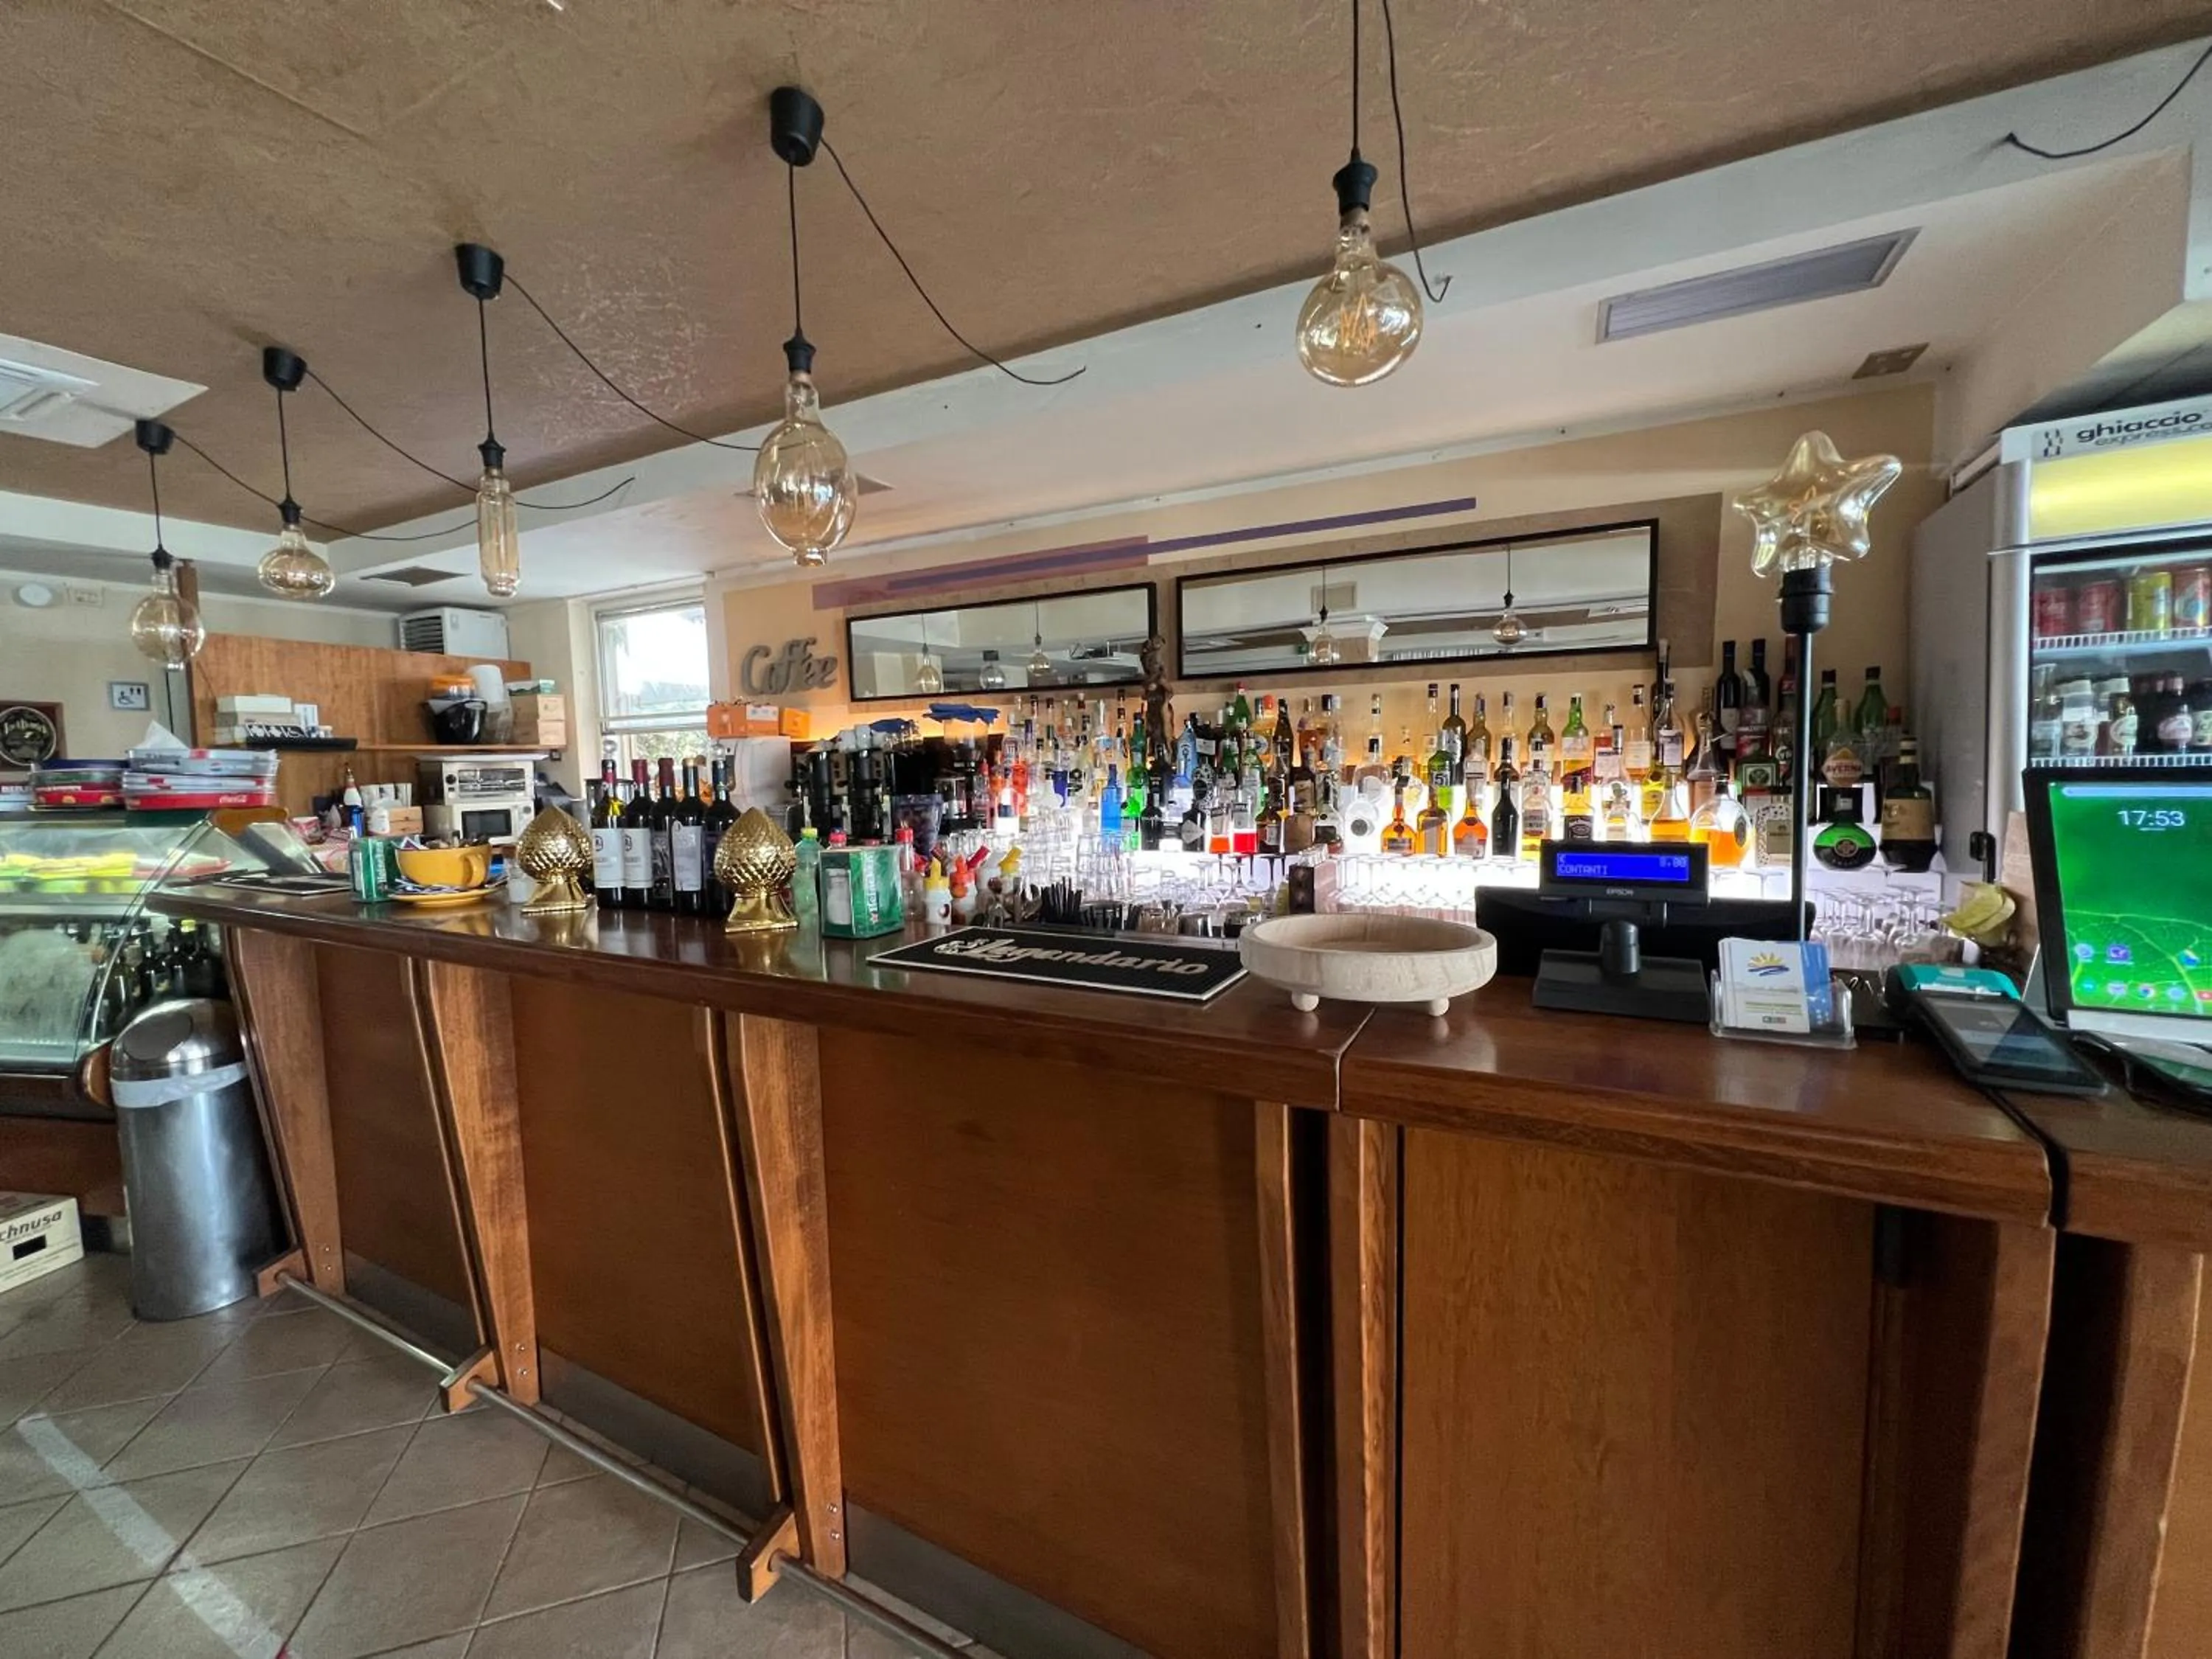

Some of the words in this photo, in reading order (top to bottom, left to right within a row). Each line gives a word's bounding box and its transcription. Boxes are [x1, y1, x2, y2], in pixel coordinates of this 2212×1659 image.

[2076, 411, 2202, 442] ghiaccio
[742, 637, 838, 695] Coffee
[2118, 810, 2185, 827] 17:53
[1559, 864, 1607, 874] CONTANTI
[1606, 888, 1634, 896] EPSON
[935, 937, 1208, 975] Legendario
